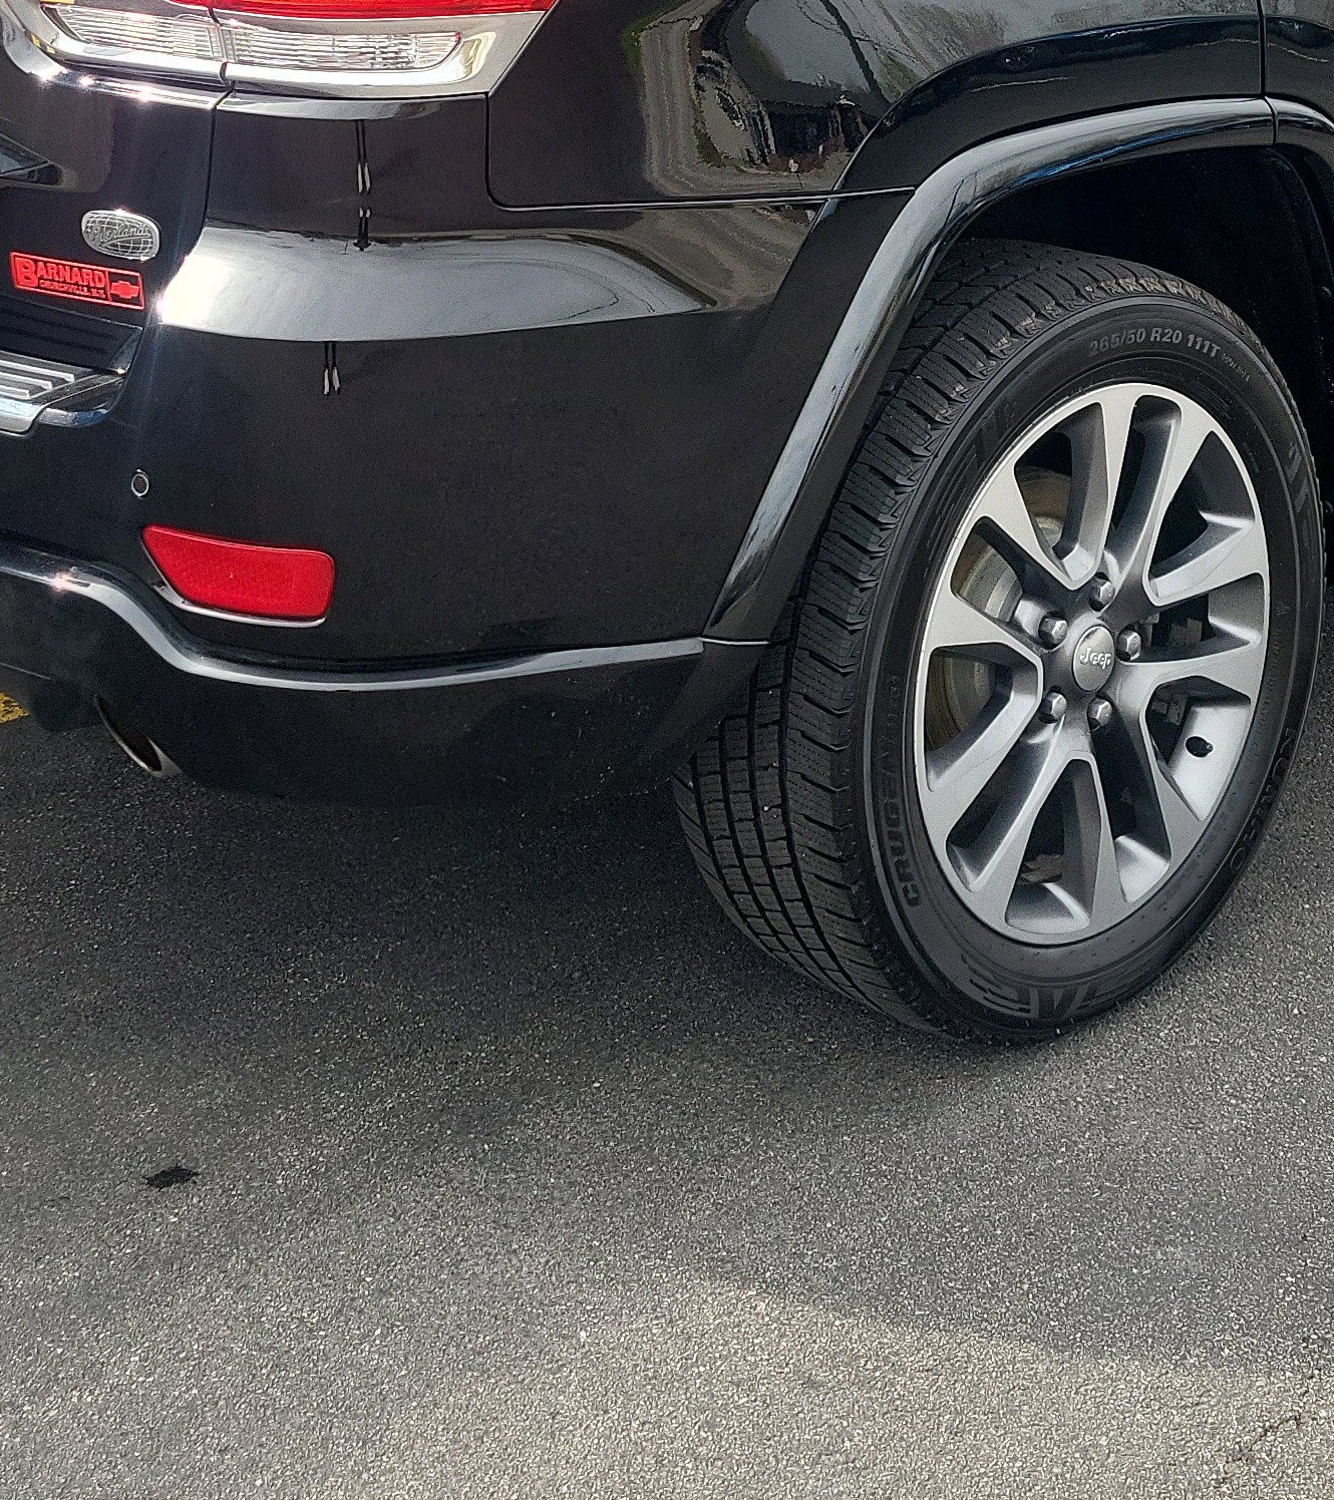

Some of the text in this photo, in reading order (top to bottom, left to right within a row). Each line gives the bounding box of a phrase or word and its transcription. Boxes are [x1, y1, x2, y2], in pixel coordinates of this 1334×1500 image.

[14, 257, 107, 288] BARNARD
[1089, 327, 1220, 358] 265/50 R20 111T
[1080, 648, 1111, 670] Jeep
